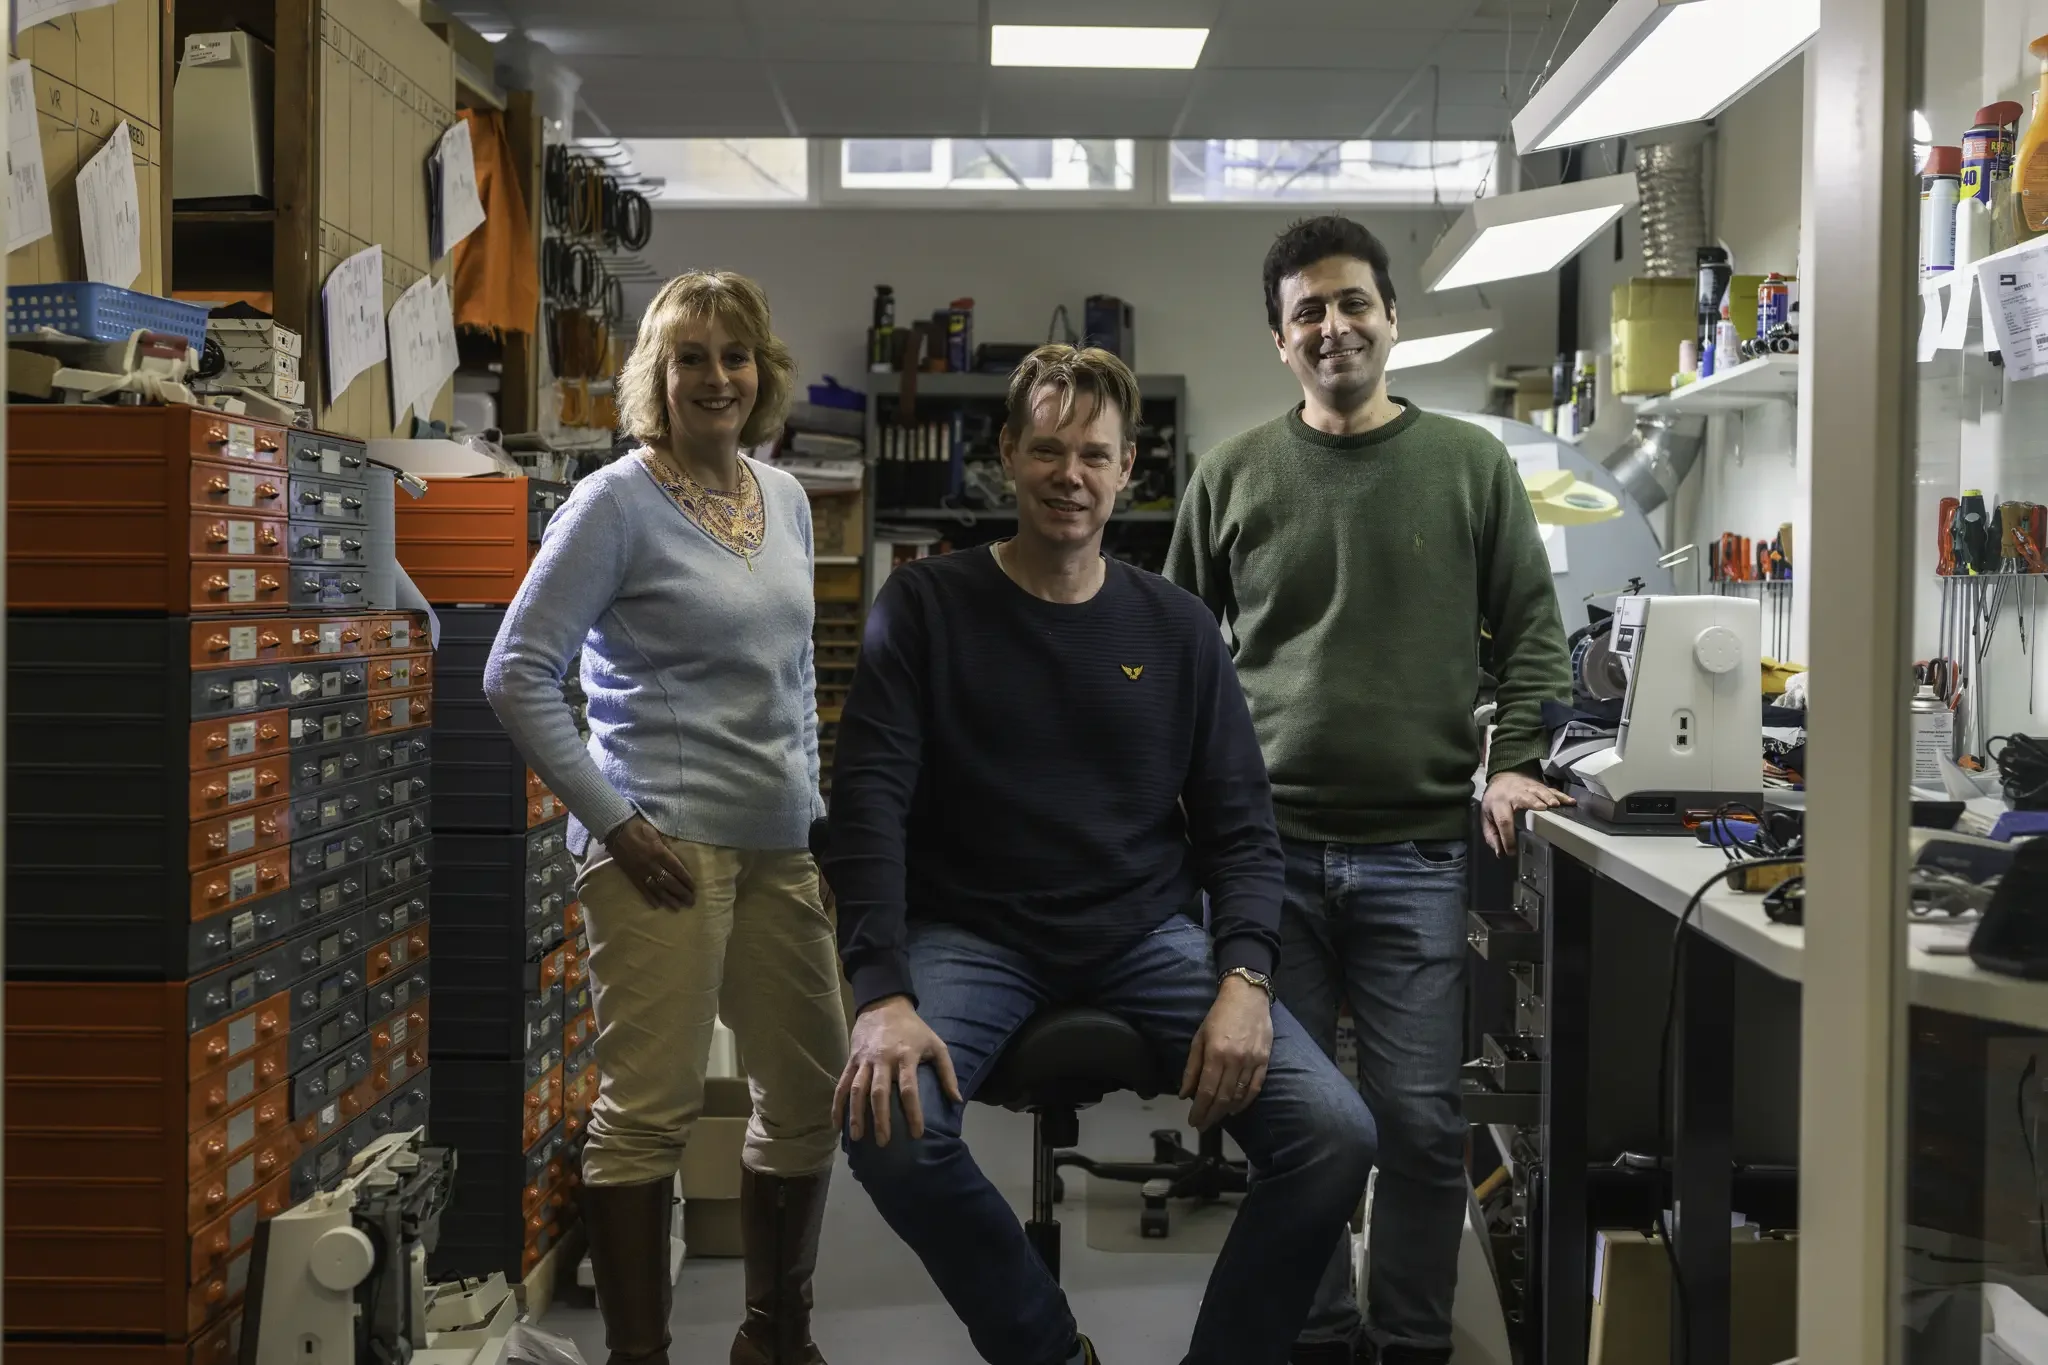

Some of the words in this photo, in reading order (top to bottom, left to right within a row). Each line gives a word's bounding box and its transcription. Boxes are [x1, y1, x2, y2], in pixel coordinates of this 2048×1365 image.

[49, 88, 61, 111] VR
[90, 107, 100, 126] ZA
[126, 123, 144, 146] REED
